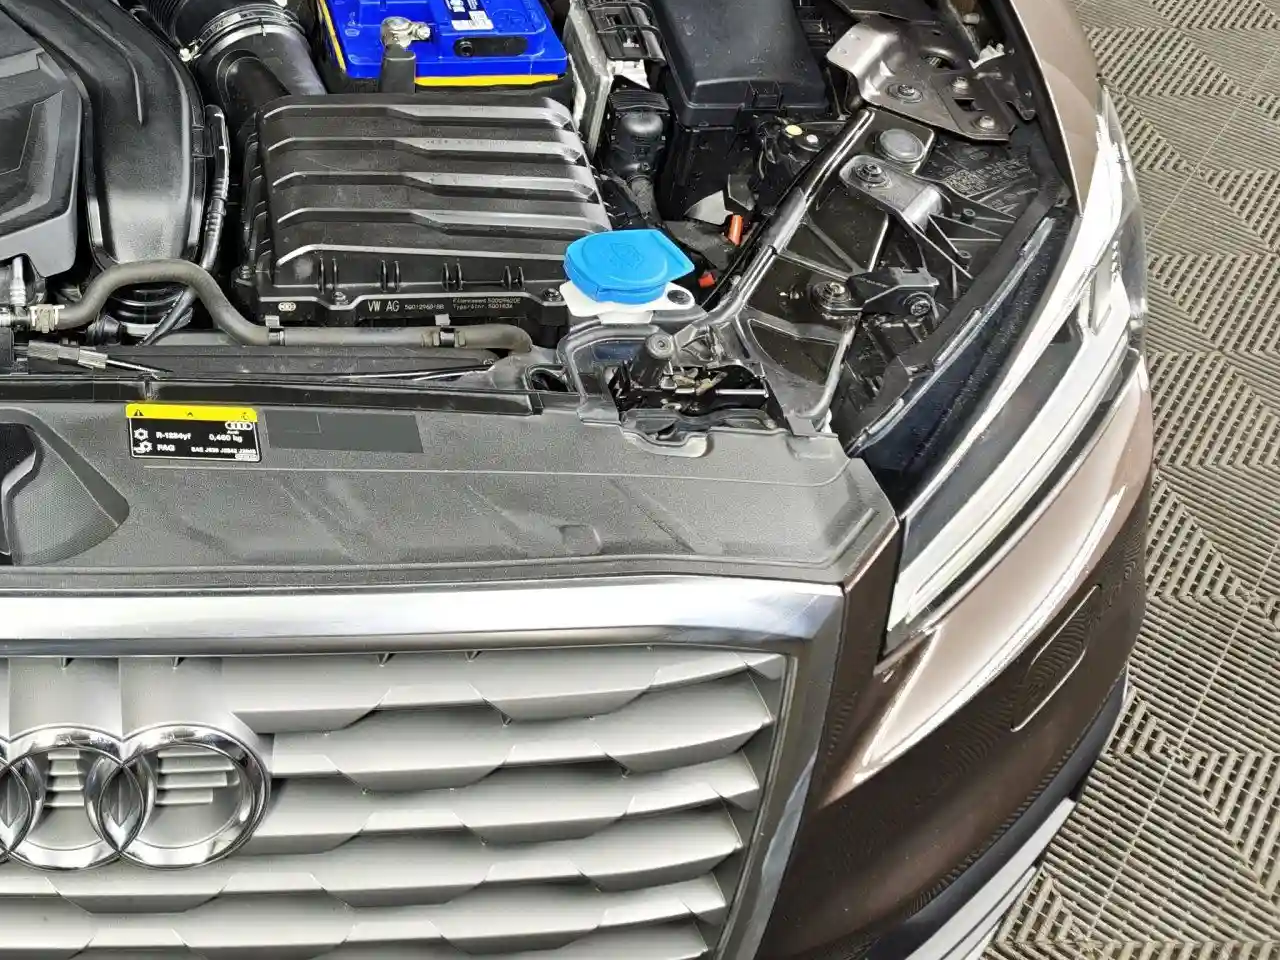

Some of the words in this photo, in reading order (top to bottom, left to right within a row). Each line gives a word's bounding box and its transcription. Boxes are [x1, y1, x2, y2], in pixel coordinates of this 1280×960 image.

[367, 300, 380, 312] VW
[385, 300, 400, 312] AG
[232, 435, 243, 443] kg
[156, 443, 176, 452] PAG
